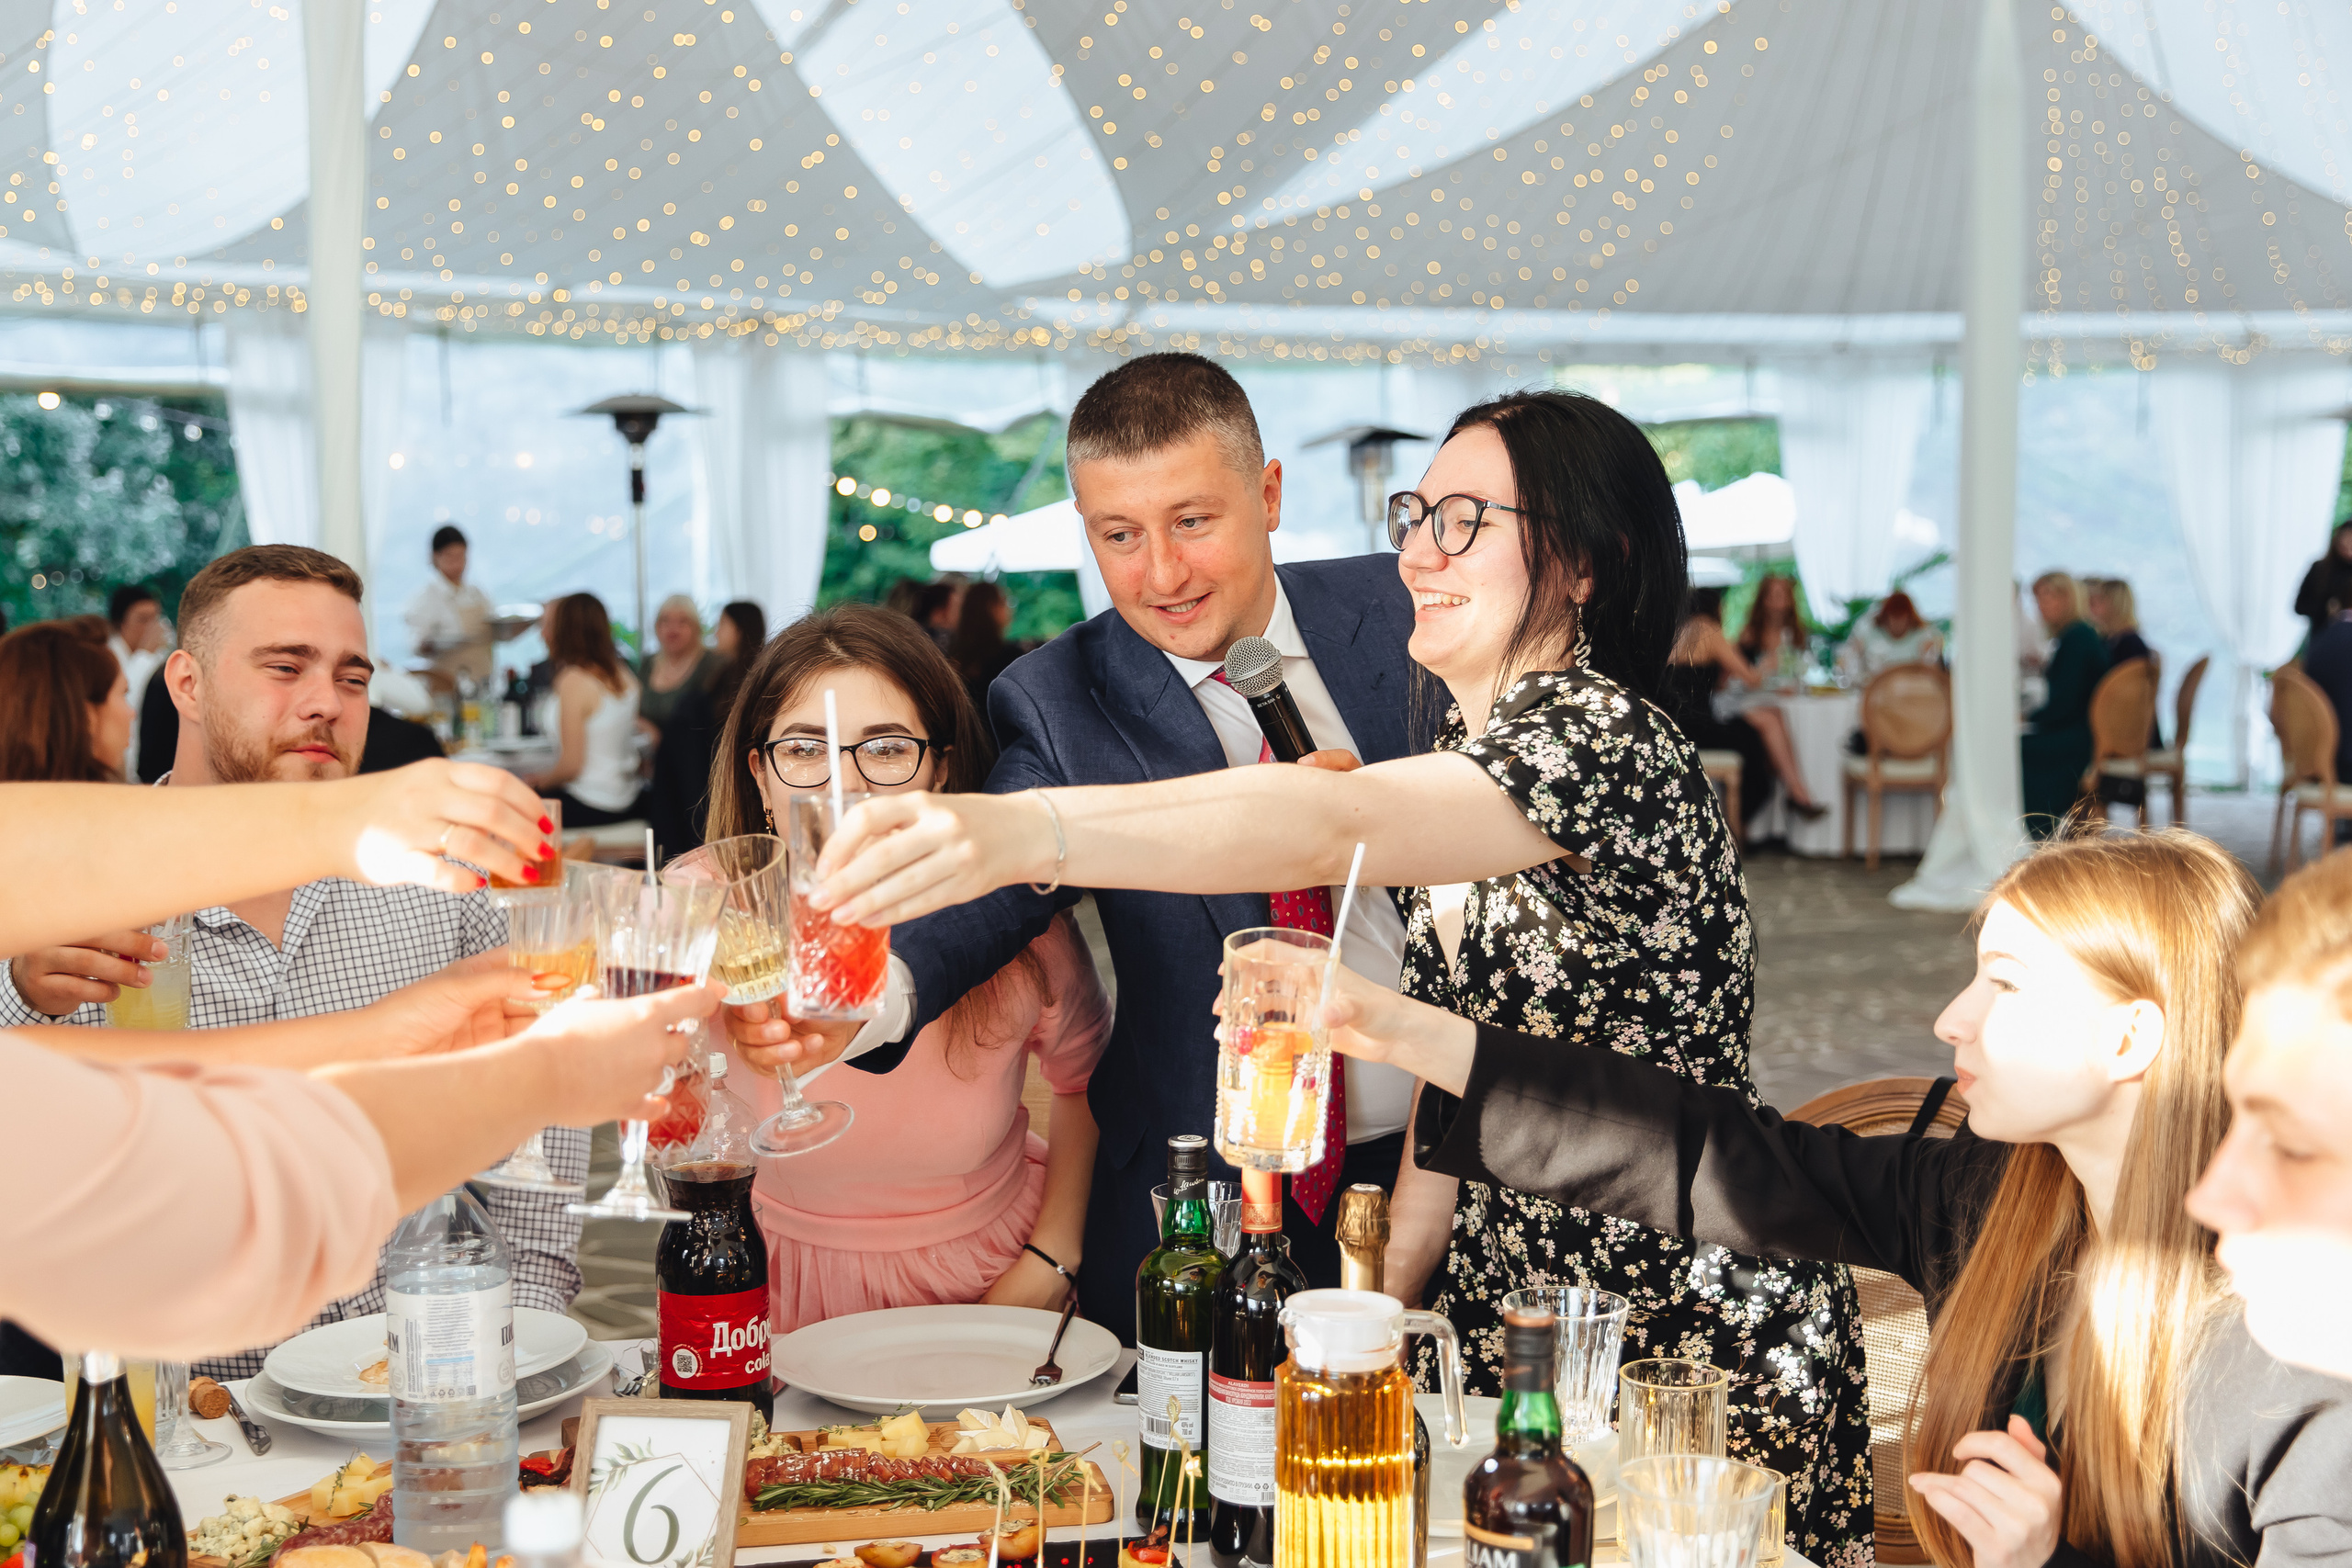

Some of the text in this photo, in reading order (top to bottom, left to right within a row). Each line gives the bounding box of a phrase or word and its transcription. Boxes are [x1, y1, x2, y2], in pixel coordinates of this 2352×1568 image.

[745, 1351, 770, 1374] cola
[1145, 1352, 1160, 1360] BLENDED
[623, 1464, 684, 1565] 6
